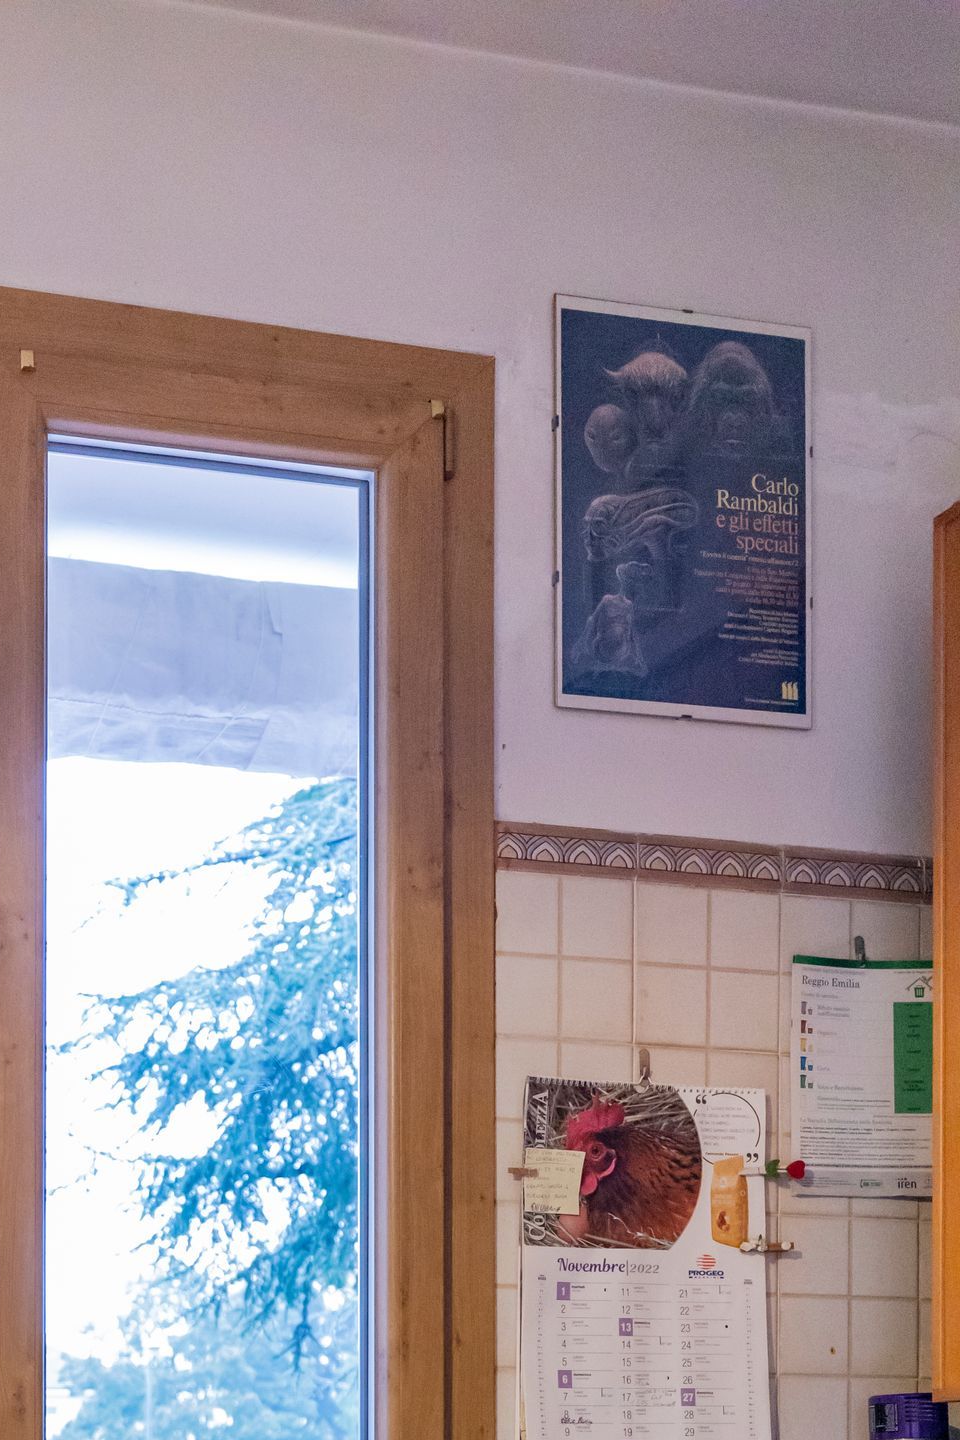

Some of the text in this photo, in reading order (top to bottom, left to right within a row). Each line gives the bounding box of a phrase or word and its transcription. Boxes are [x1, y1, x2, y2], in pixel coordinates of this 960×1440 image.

[752, 474, 799, 496] Carlo
[716, 489, 798, 515] Rambaldi
[716, 512, 798, 535] e gli effetti
[736, 536, 799, 555] speciali
[802, 975, 860, 989] Reggio Emilia
[897, 1177, 917, 1189] iren
[557, 1258, 660, 1274] Novembre 2022
[621, 1288, 630, 1296] 11
[679, 1289, 688, 1298] 21
[622, 1305, 631, 1314] 12
[680, 1306, 690, 1316] 22
[621, 1322, 632, 1332] 13
[681, 1324, 691, 1333] 23
[681, 1341, 691, 1350] 24
[622, 1358, 632, 1367] 15
[682, 1358, 692, 1367] 25
[622, 1375, 632, 1384] 16
[683, 1376, 693, 1384] 26
[622, 1393, 631, 1401] 17
[683, 1393, 694, 1402] 27
[623, 1410, 632, 1419] 18
[684, 1410, 694, 1419] 28
[624, 1428, 633, 1437] 19
[685, 1428, 695, 1436] 29
